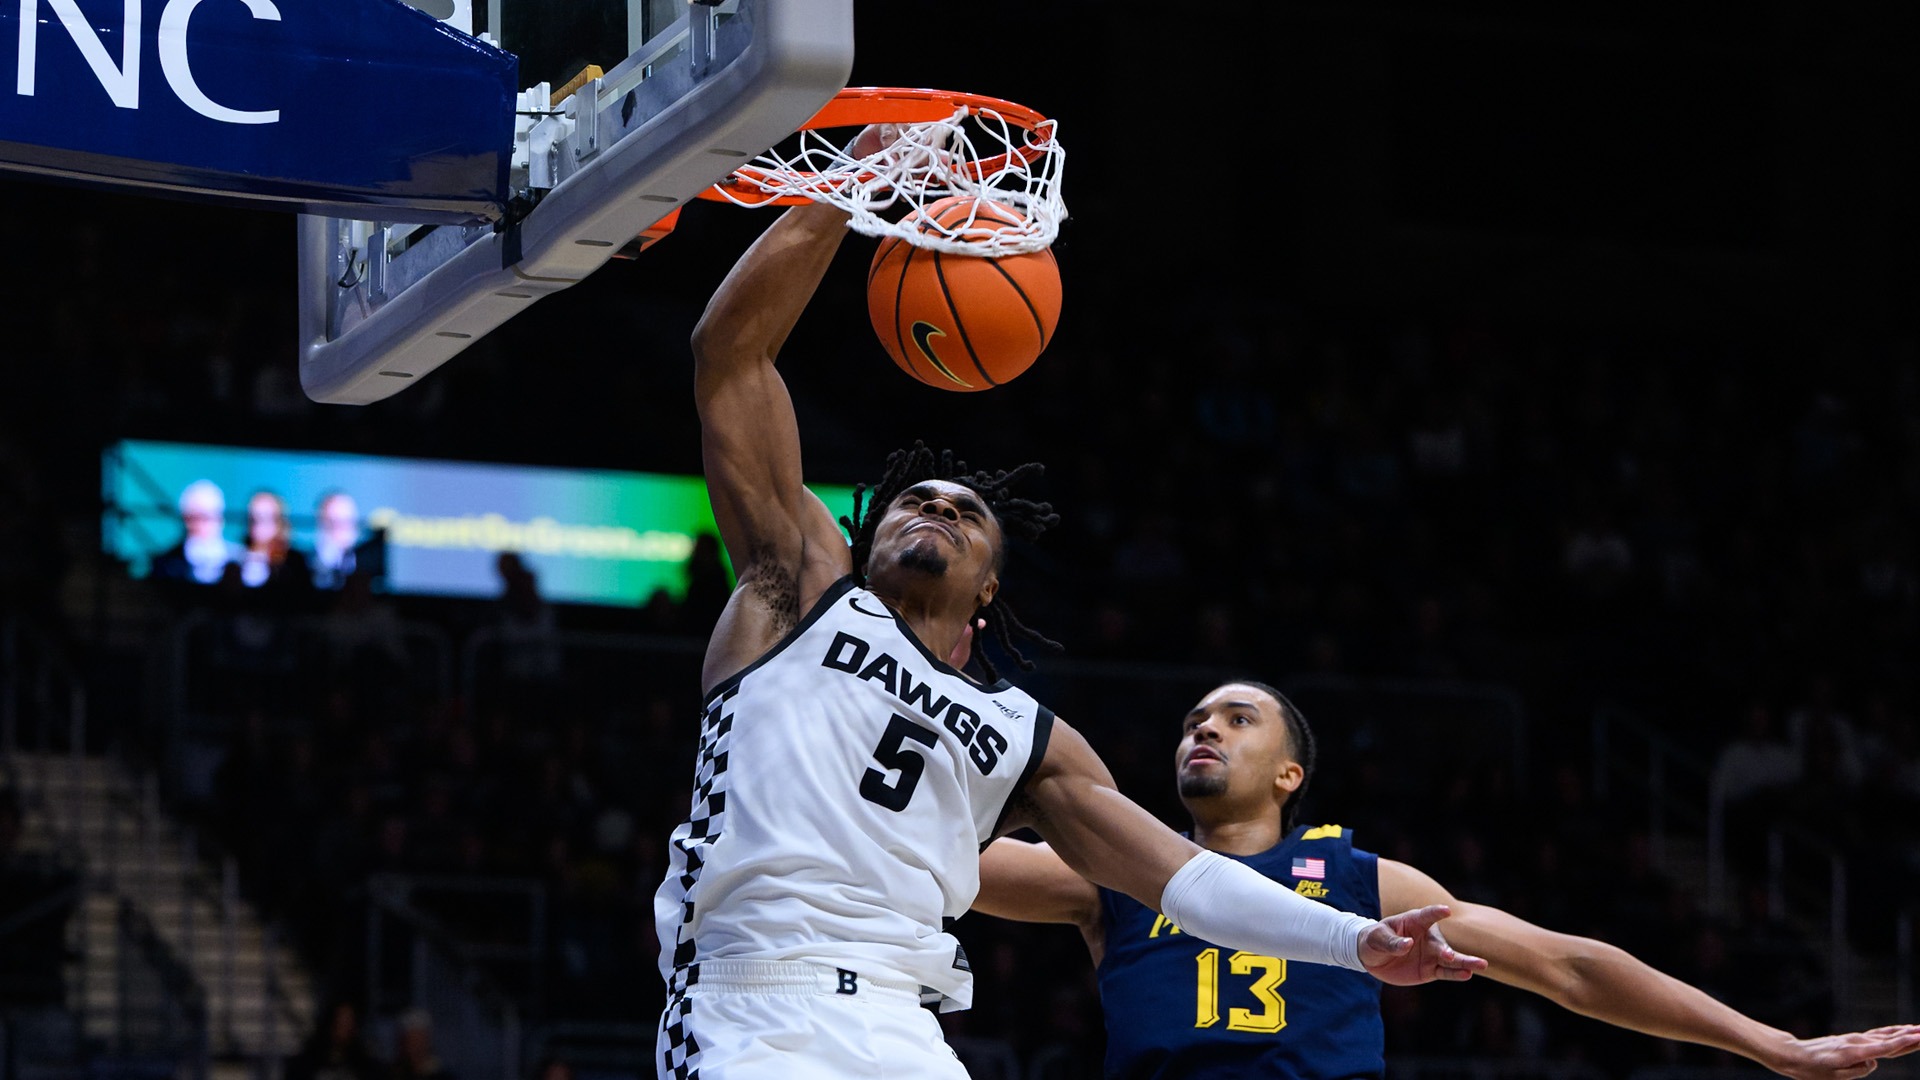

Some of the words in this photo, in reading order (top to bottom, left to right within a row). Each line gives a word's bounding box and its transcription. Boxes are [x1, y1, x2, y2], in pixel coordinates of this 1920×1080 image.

[821, 630, 1008, 776] DAWGS
[859, 713, 939, 812] 5
[1295, 888, 1329, 897] EAST
[1298, 880, 1323, 889] BIG
[836, 968, 858, 995] B
[1195, 948, 1288, 1033] 13
